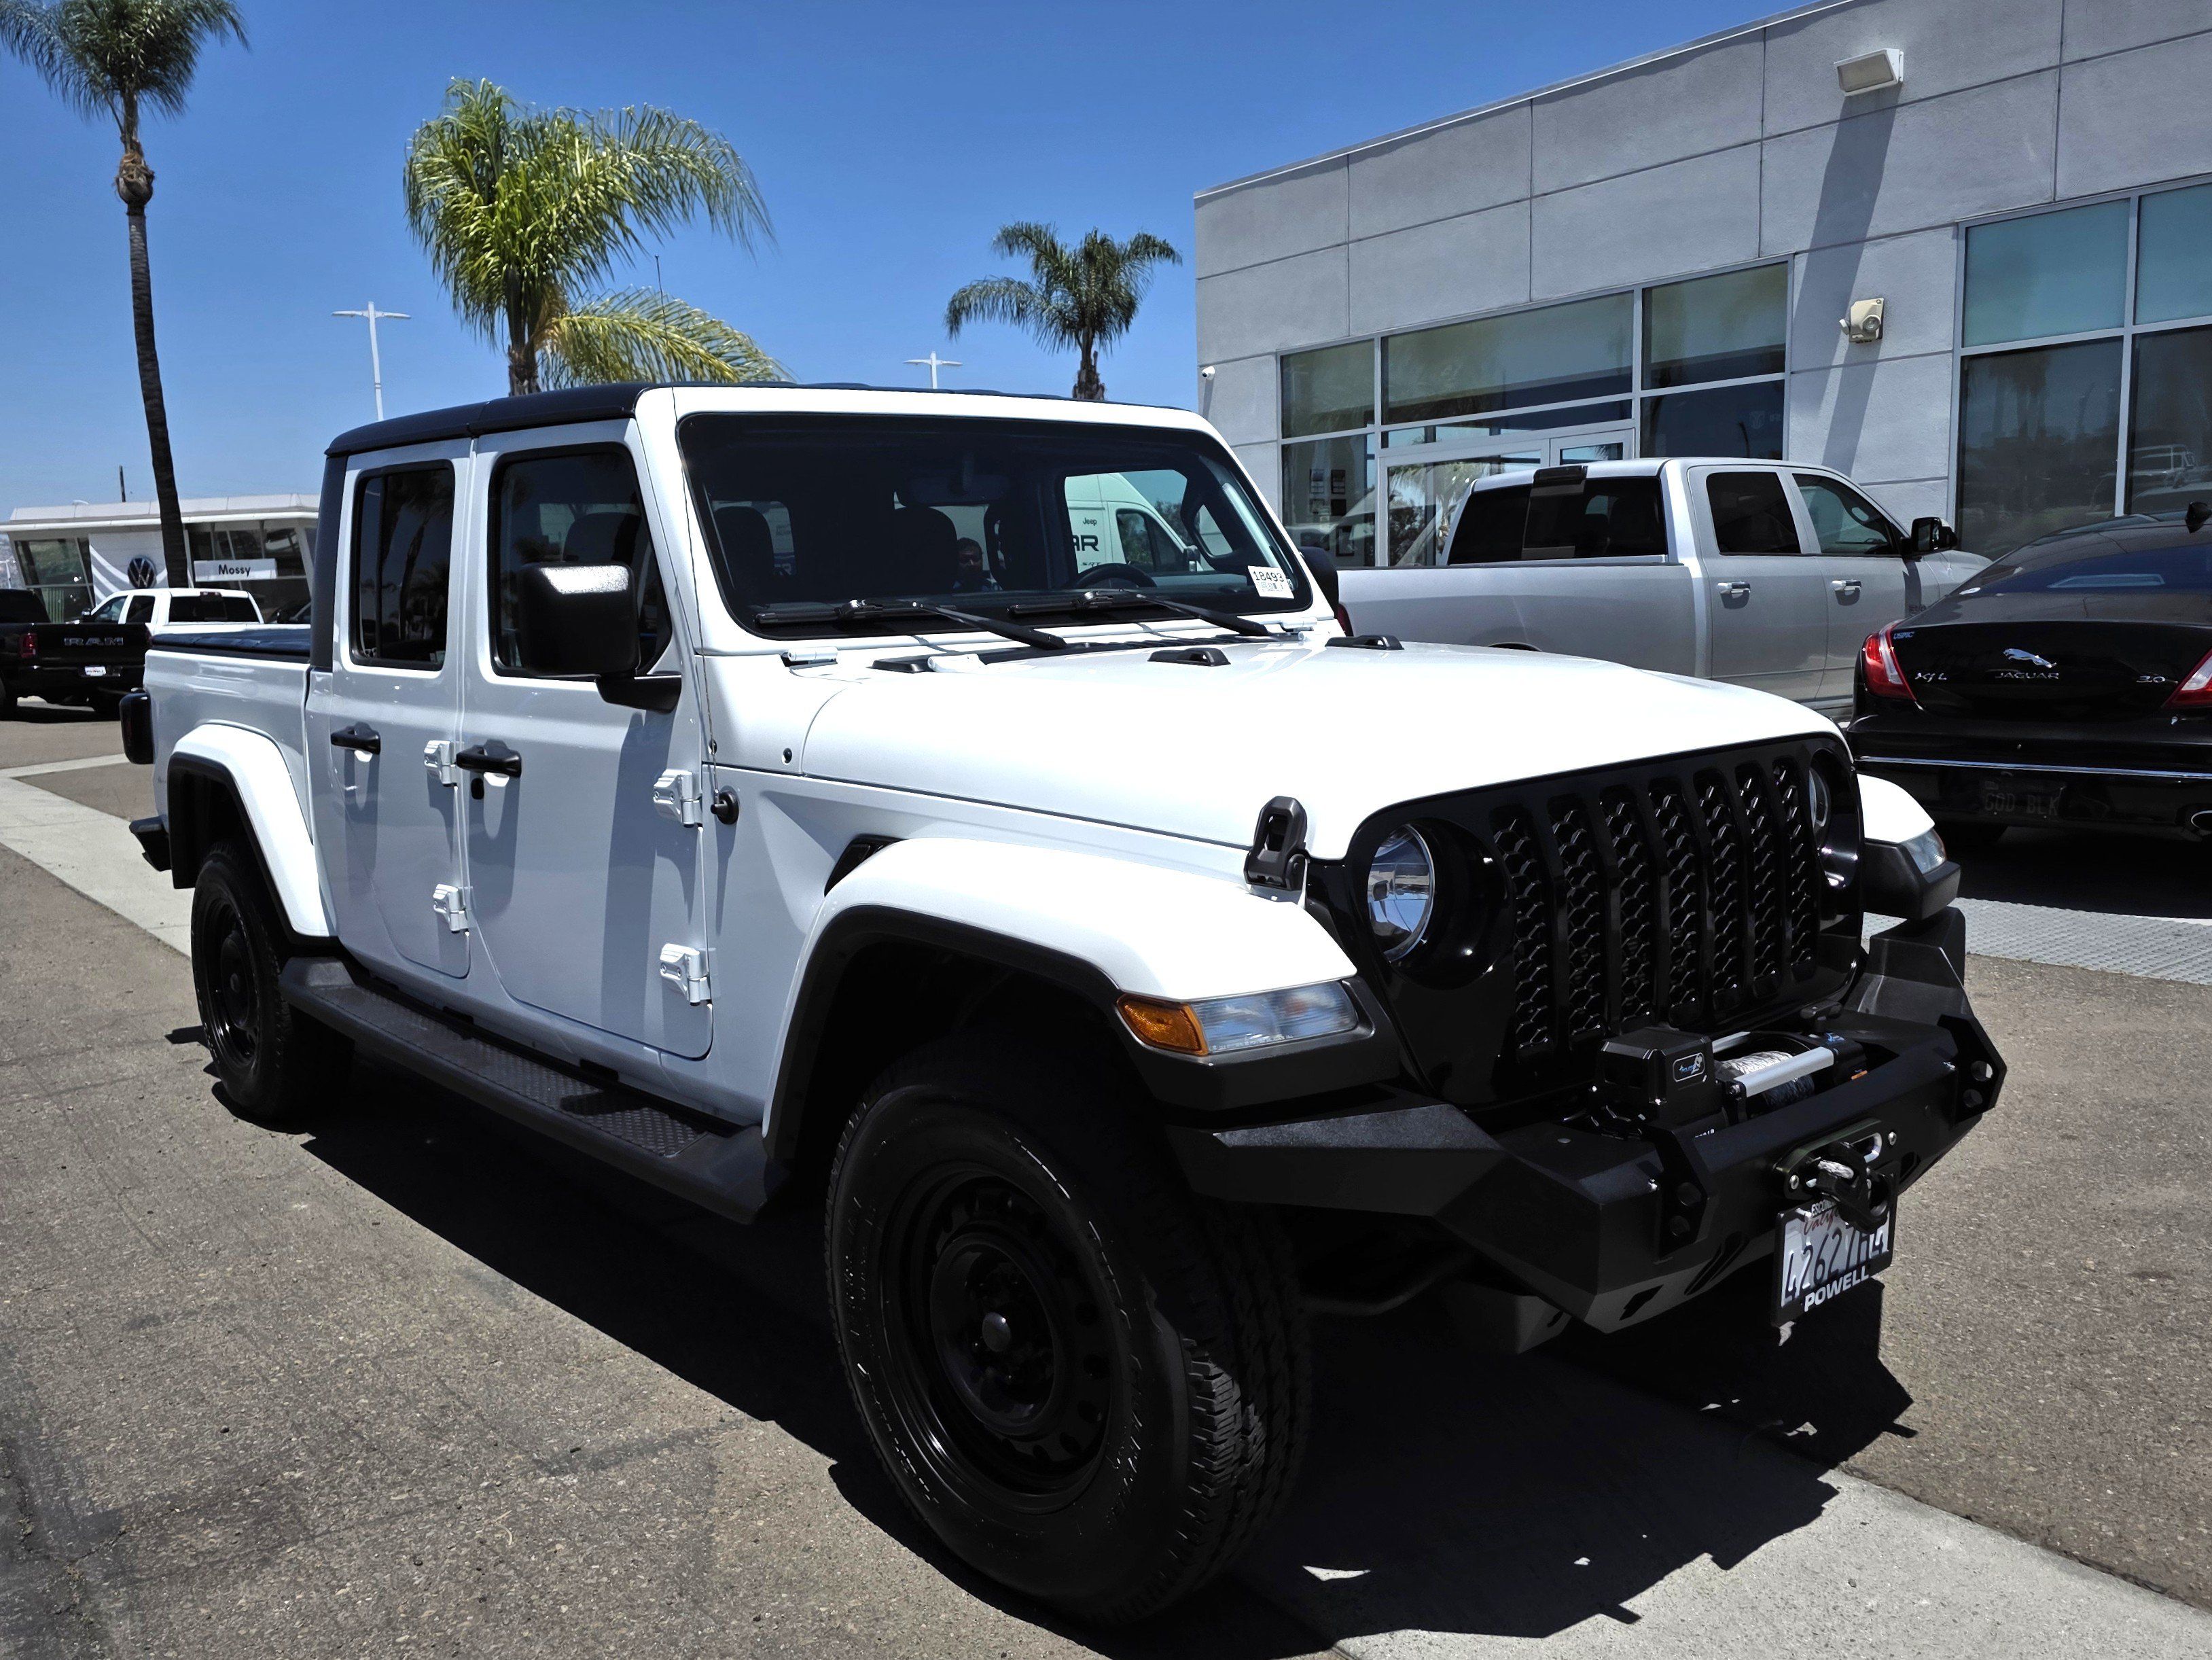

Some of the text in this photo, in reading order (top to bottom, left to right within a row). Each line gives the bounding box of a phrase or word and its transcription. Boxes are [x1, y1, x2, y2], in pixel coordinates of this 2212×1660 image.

[1082, 517, 1097, 526] Jeep
[218, 563, 251, 577] Mossy
[1253, 570, 1285, 582] 18493
[64, 637, 124, 646] RAM
[1995, 671, 2060, 679] JAGUAR
[1804, 1265, 1869, 1313] POWELL
